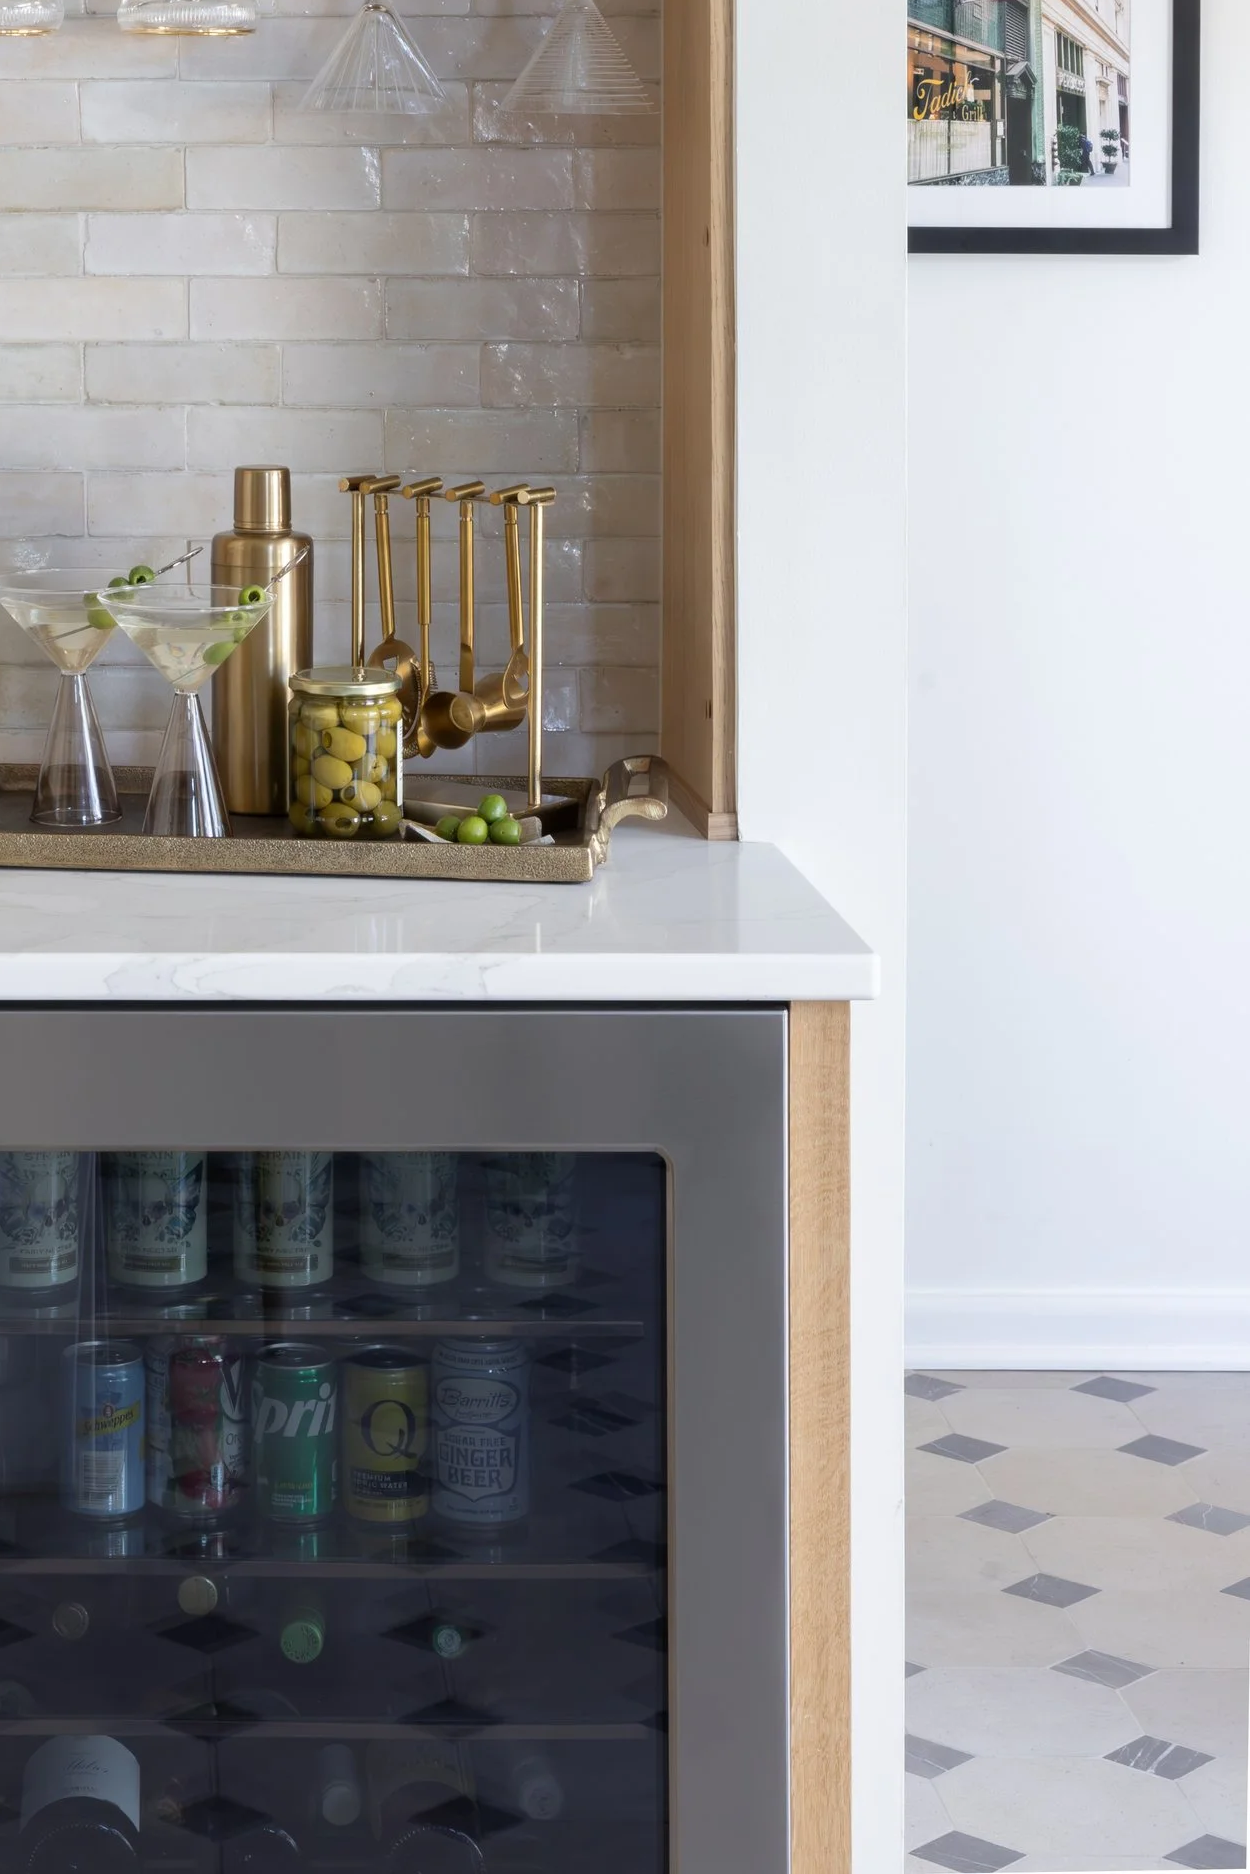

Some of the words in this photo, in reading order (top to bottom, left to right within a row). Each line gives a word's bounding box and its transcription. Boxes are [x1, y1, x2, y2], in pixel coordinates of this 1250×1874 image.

[962, 104, 984, 122] Grill
[82, 1409, 135, 1436] Schweppes
[361, 1399, 418, 1459] Q
[439, 1442, 512, 1468] GINGER
[448, 1465, 502, 1490] BEER
